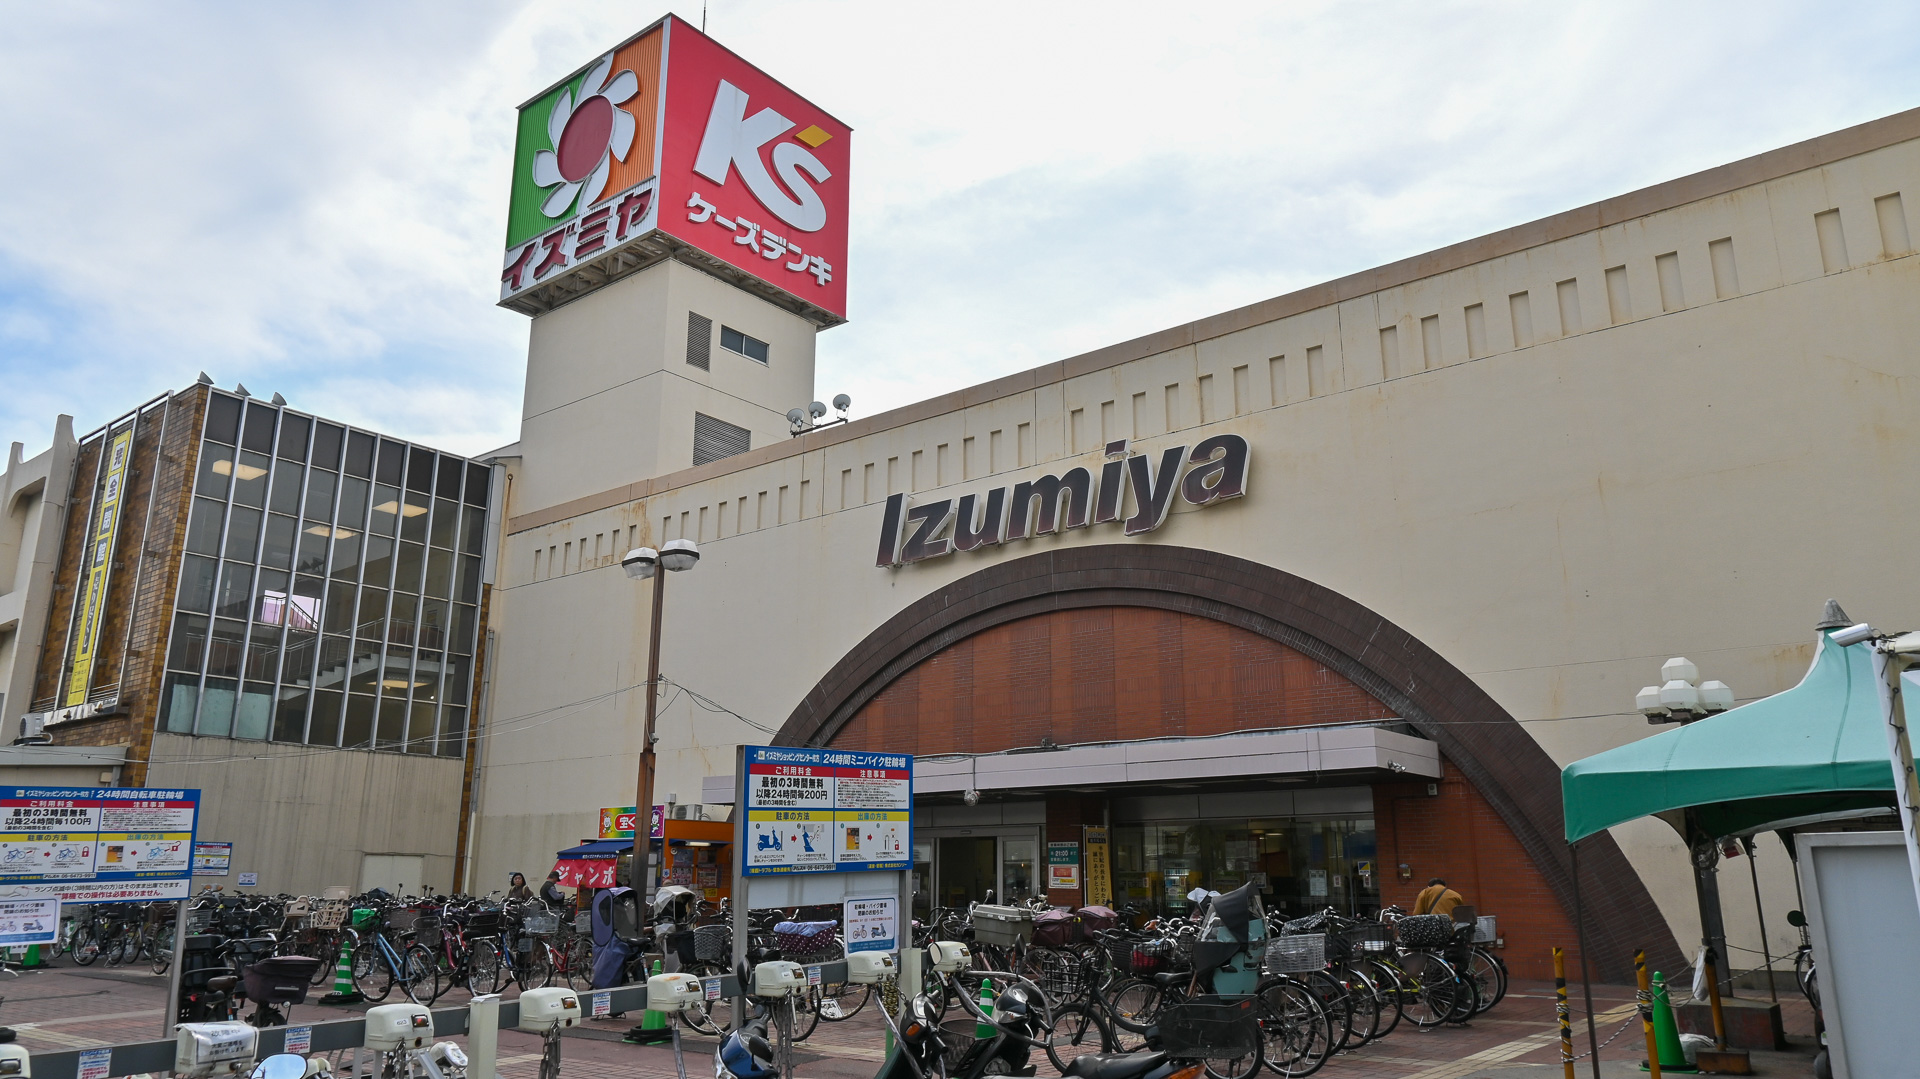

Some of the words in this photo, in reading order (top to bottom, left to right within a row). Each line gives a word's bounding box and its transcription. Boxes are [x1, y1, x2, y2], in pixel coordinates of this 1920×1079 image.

[501, 188, 653, 291] イズミヤ
[687, 192, 833, 286] ケーズデンキ
[875, 433, 1252, 568] Izumiya
[823, 754, 906, 768] 24時間ミニバイク駐輪場
[776, 766, 812, 776] ご利用料金
[860, 769, 886, 778] 注意事項
[761, 776, 824, 789] 最初の3時間無料
[96, 790, 184, 800] 24時間自転車駐輪場
[756, 788, 828, 800] 以降24時間毎200円
[13, 808, 87, 817] 最初の3時間無料
[776, 811, 810, 821] 駐車の方法
[857, 812, 888, 821] 出庫の方法
[5, 817, 91, 826] 以降24時間毎100円
[619, 816, 636, 829] 宝く
[27, 834, 69, 842] 駐車の方法
[556, 866, 615, 885] ジャンボ
[54, 889, 164, 900] 算機での操作は必要ありません。
